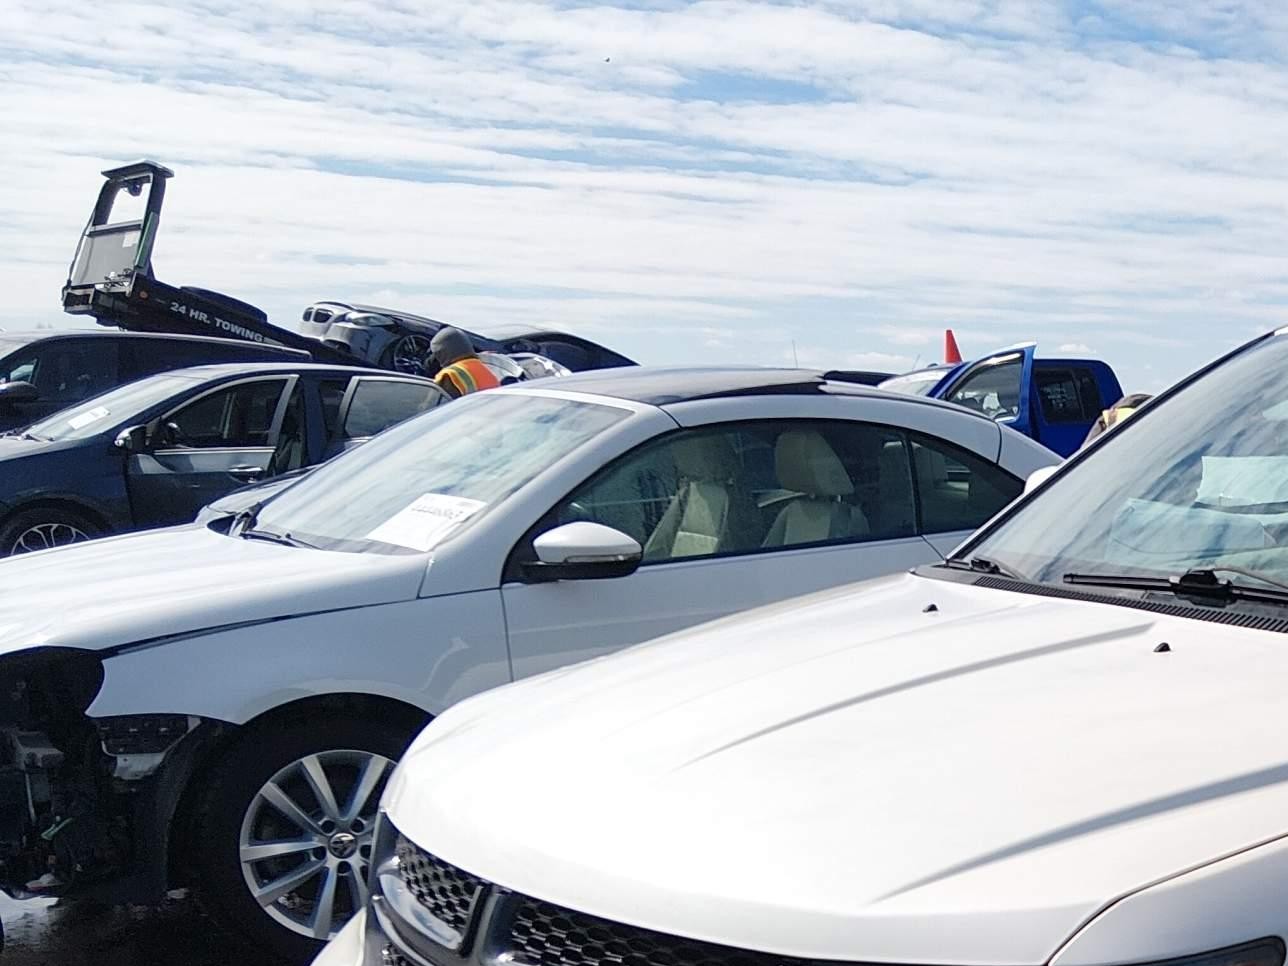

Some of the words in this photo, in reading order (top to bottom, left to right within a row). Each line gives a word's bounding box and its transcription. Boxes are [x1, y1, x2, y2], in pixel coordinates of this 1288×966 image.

[170, 302, 186, 314] 24
[189, 308, 211, 324] HR.
[214, 317, 263, 343] TOWING
